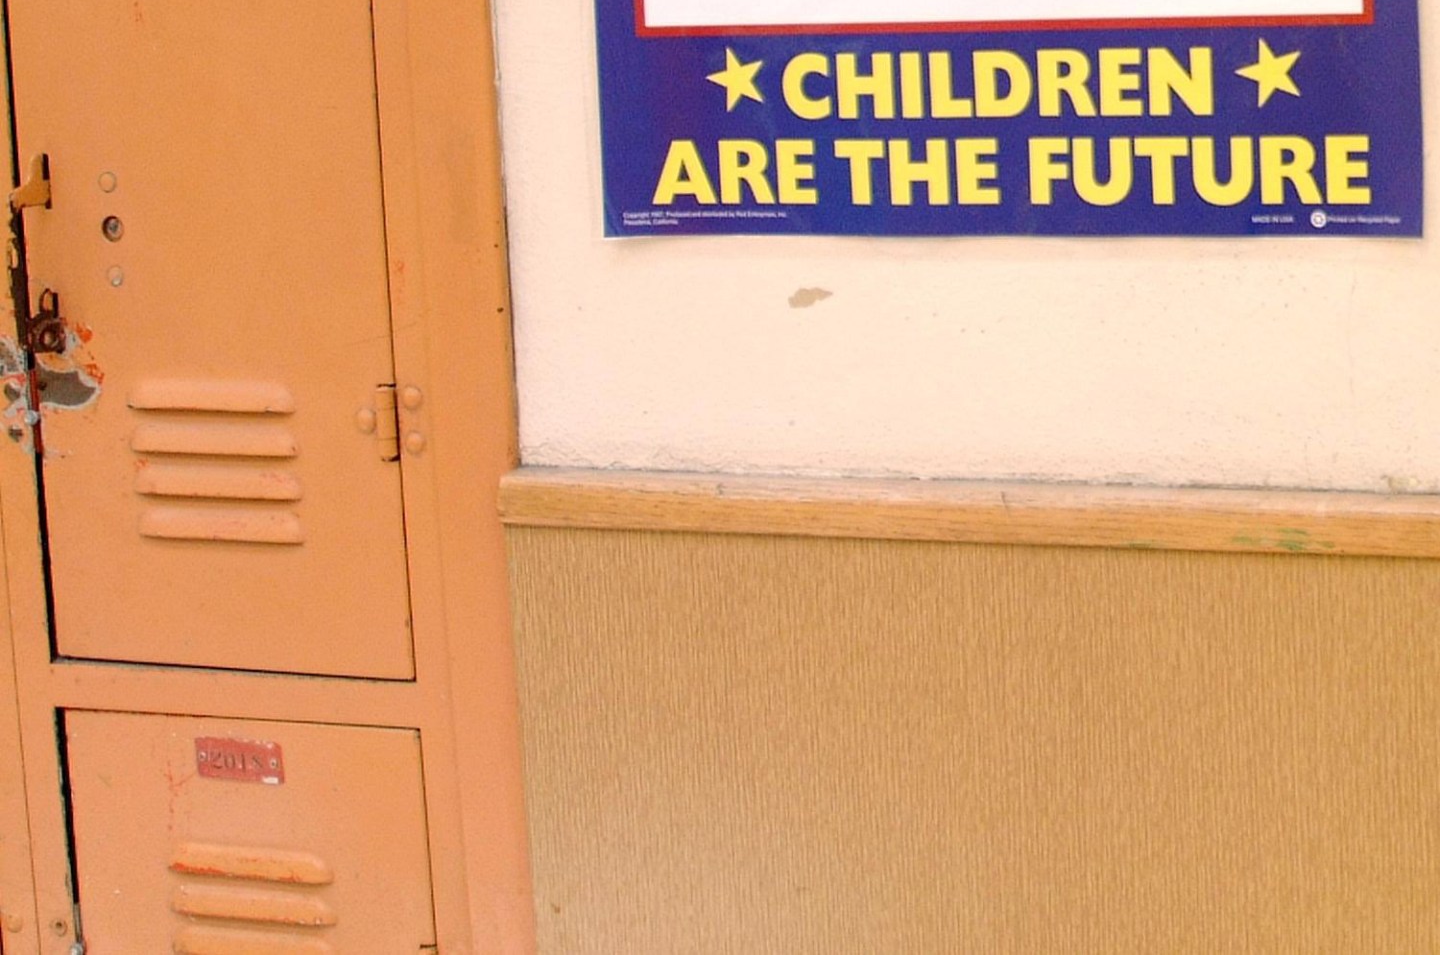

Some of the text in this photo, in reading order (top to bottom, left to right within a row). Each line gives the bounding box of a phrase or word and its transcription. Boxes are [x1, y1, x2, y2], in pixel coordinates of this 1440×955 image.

[782, 47, 1213, 120] CHILDREN
[652, 135, 1371, 207] ARE THE FUTURE
